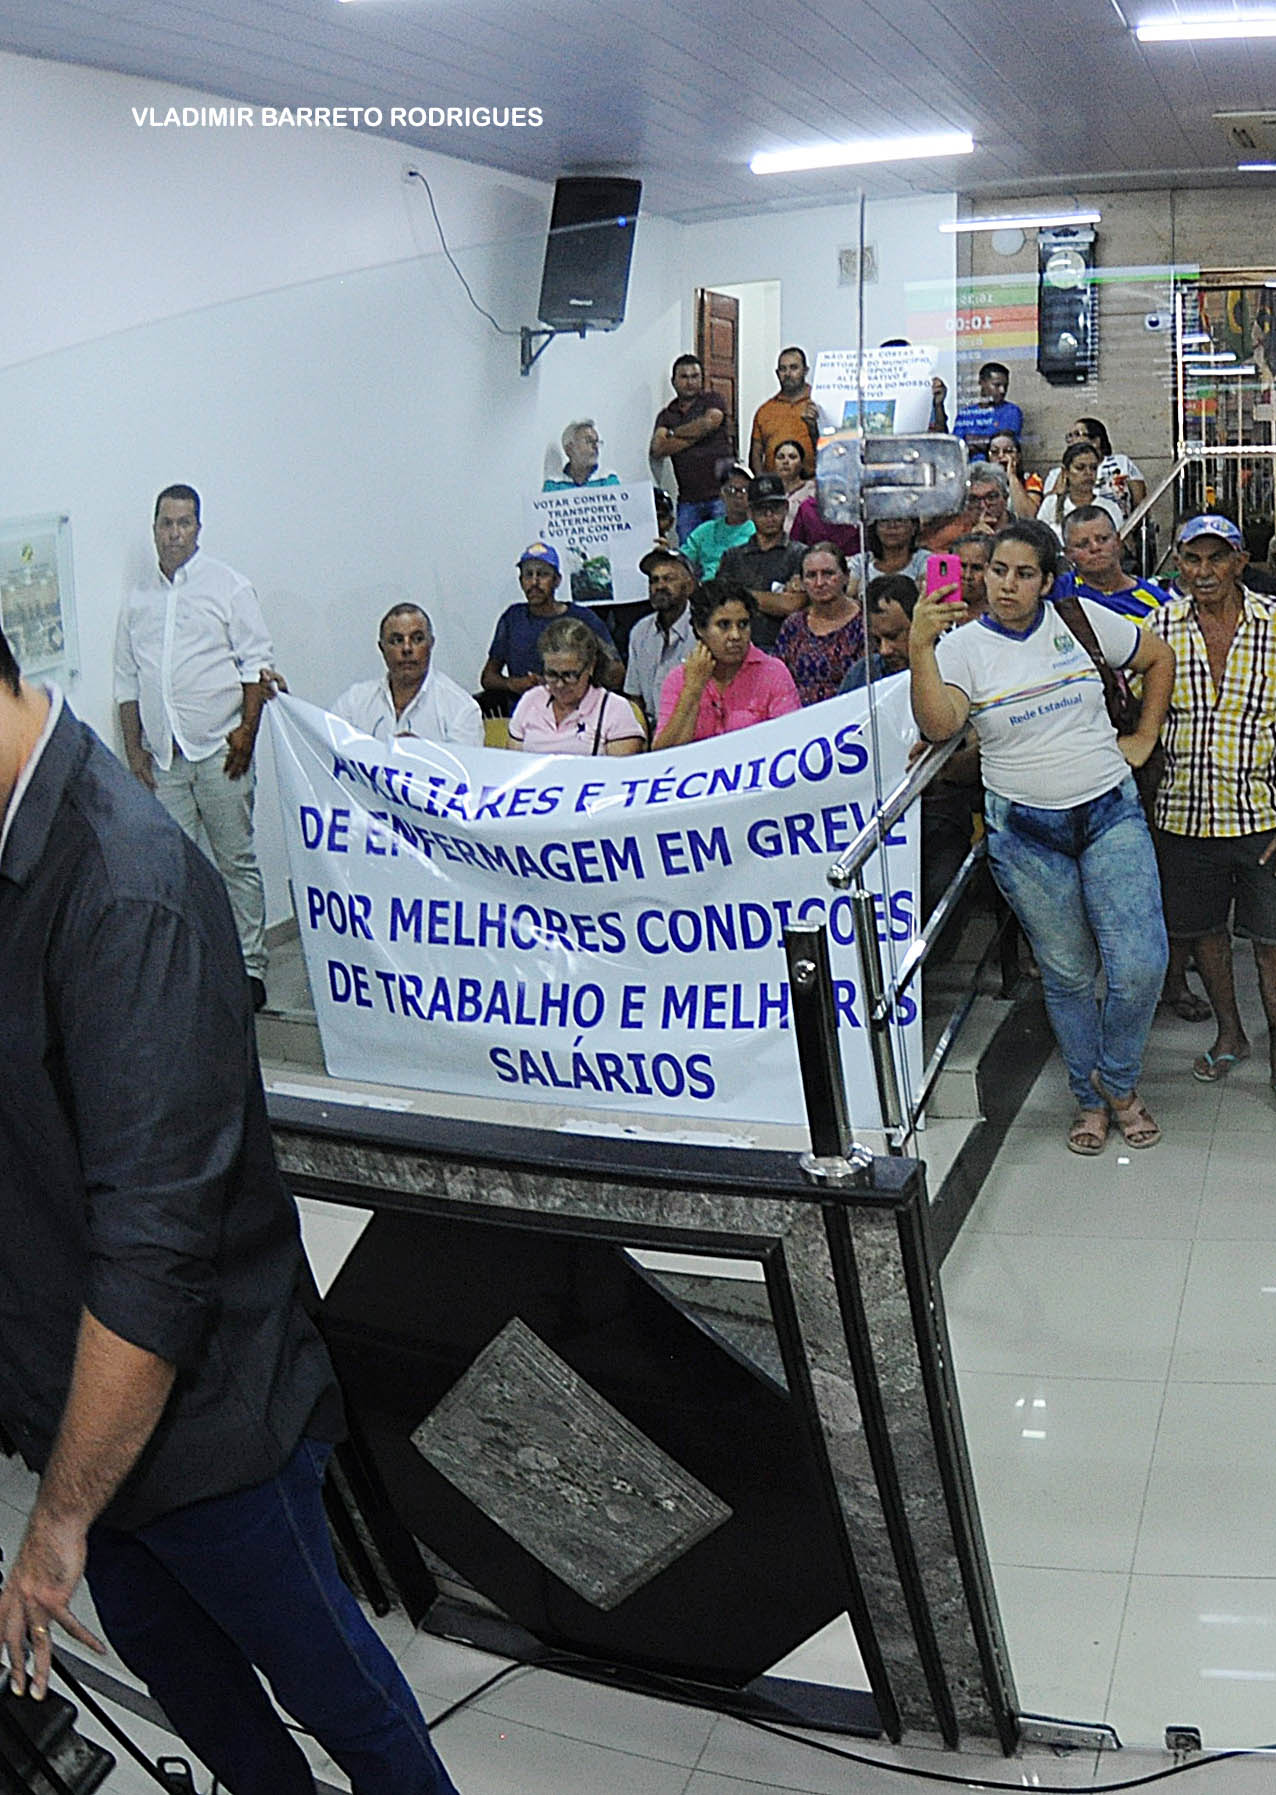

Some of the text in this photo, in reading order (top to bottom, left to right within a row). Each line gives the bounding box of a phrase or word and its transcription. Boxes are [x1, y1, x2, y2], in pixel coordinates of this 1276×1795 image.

[533, 491, 629, 510] VOTAR CONTRA O
[548, 504, 618, 519] TRANSPORTE
[547, 513, 622, 528] ALTERNATIVO
[548, 528, 585, 538] VOTAR
[587, 521, 632, 534] CONTRA
[568, 533, 609, 546] O POVO
[1008, 692, 1083, 726] Rede Estadual
[575, 782, 606, 813] E
[622, 724, 870, 808] TÉCNICOS
[300, 806, 348, 853] DE
[365, 810, 646, 884] ENFERMAGEM
[656, 826, 733, 877] EM
[307, 886, 374, 941] POR
[389, 896, 627, 954] MELHORES
[328, 959, 918, 1030] DE TRABALHO E MELHRS
[488, 1035, 716, 1100] SALÁRIOS
